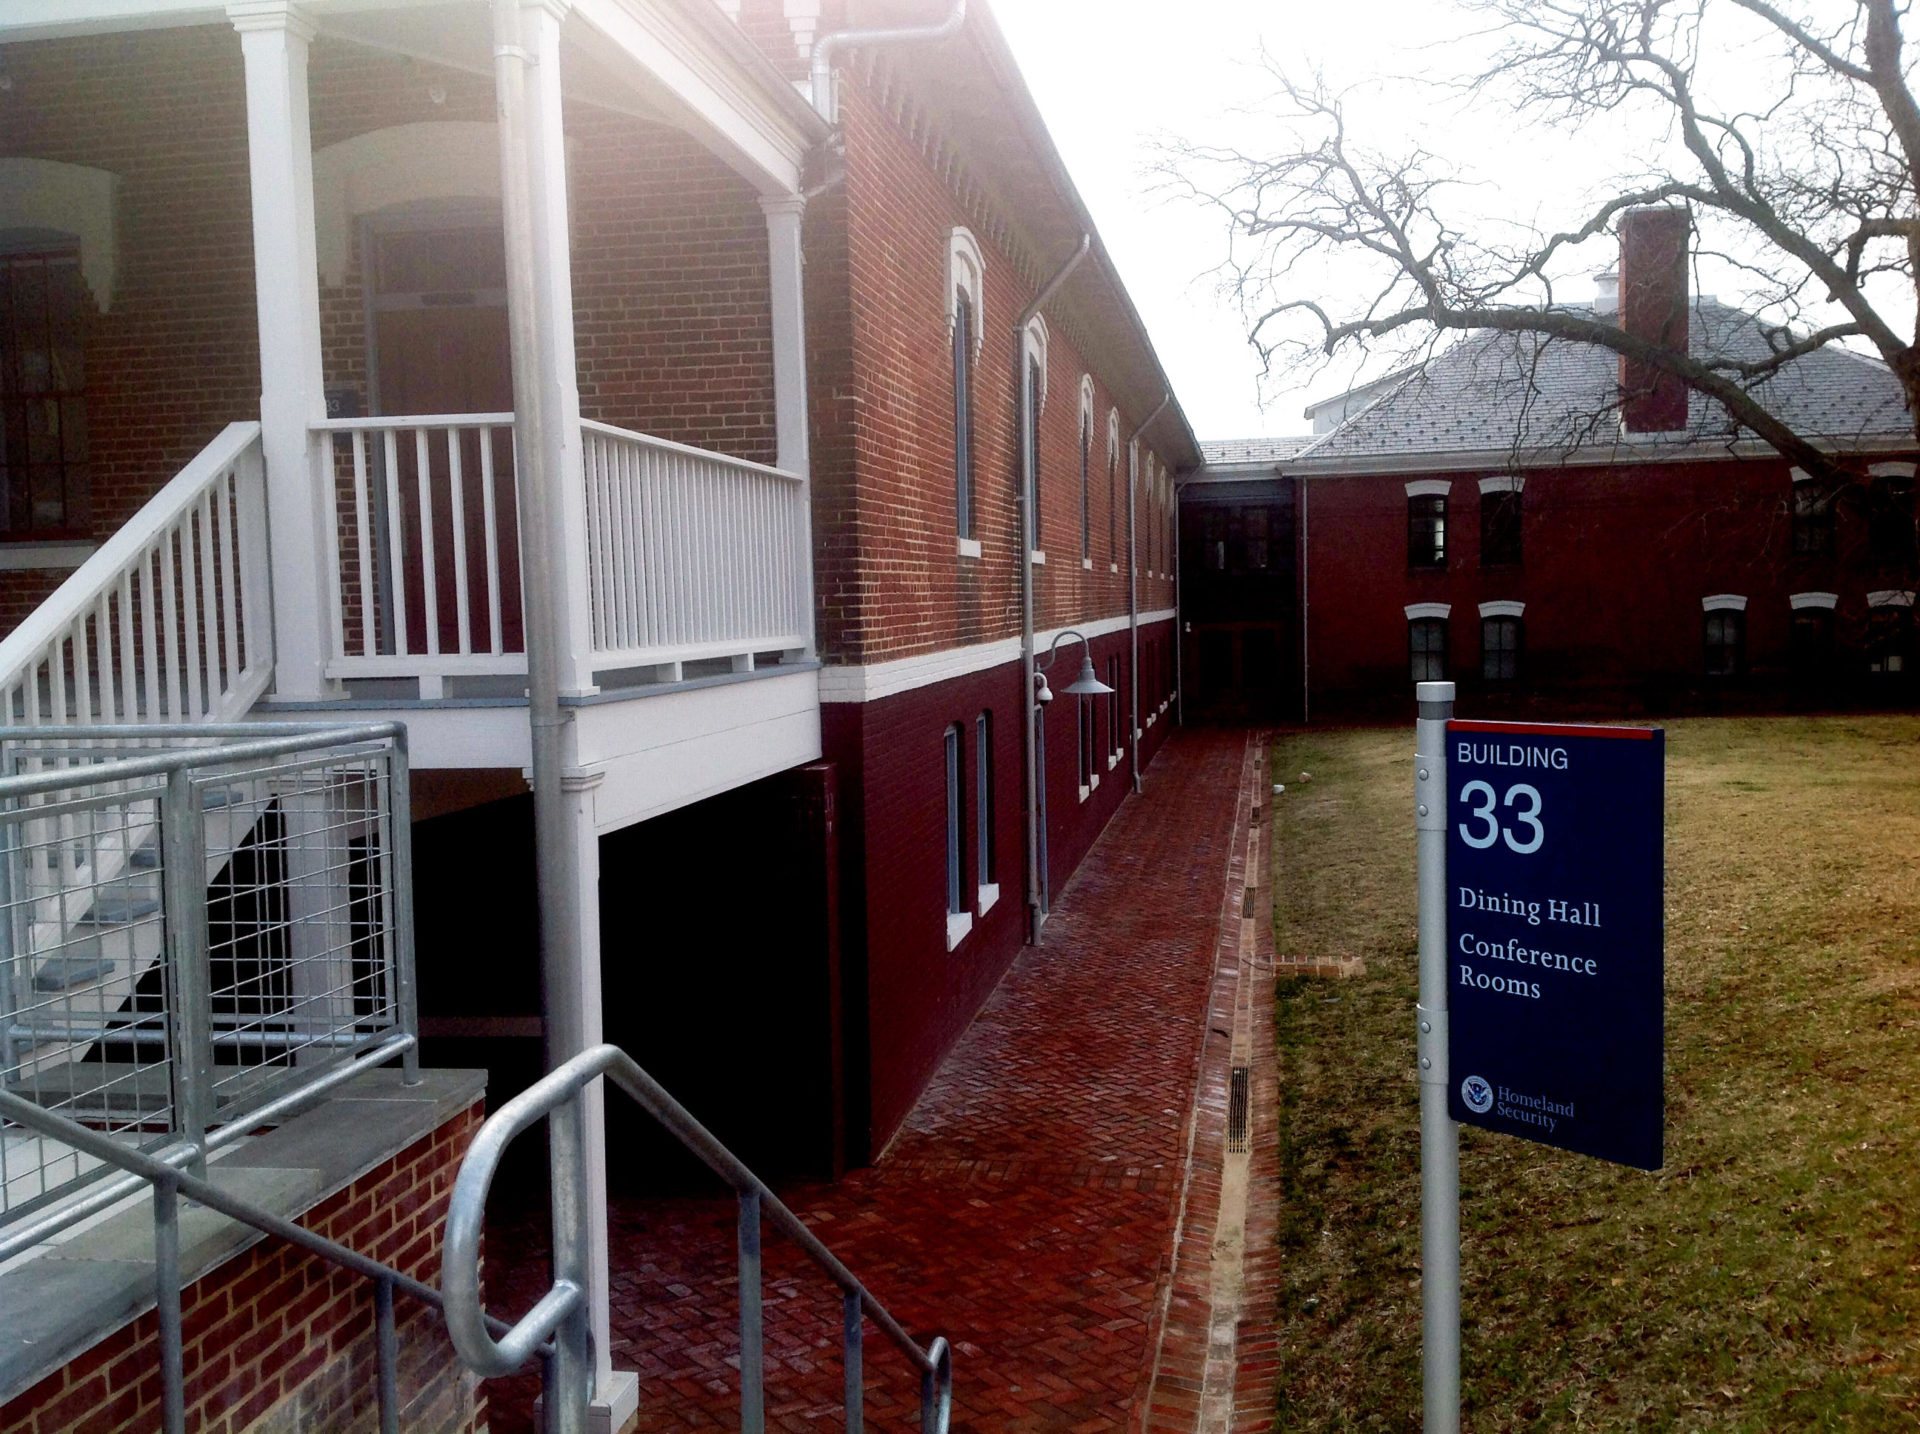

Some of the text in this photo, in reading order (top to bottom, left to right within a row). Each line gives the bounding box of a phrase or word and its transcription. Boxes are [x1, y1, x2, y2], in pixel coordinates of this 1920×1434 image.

[1458, 742, 1568, 769] BUILDING
[1459, 780, 1544, 854] 33
[1459, 887, 1601, 927] Dining Hall
[1459, 933, 1597, 975] Conference
[1459, 965, 1540, 999] Rooms
[1497, 1101, 1557, 1133] Security
[1498, 1086, 1575, 1118] Homeland
